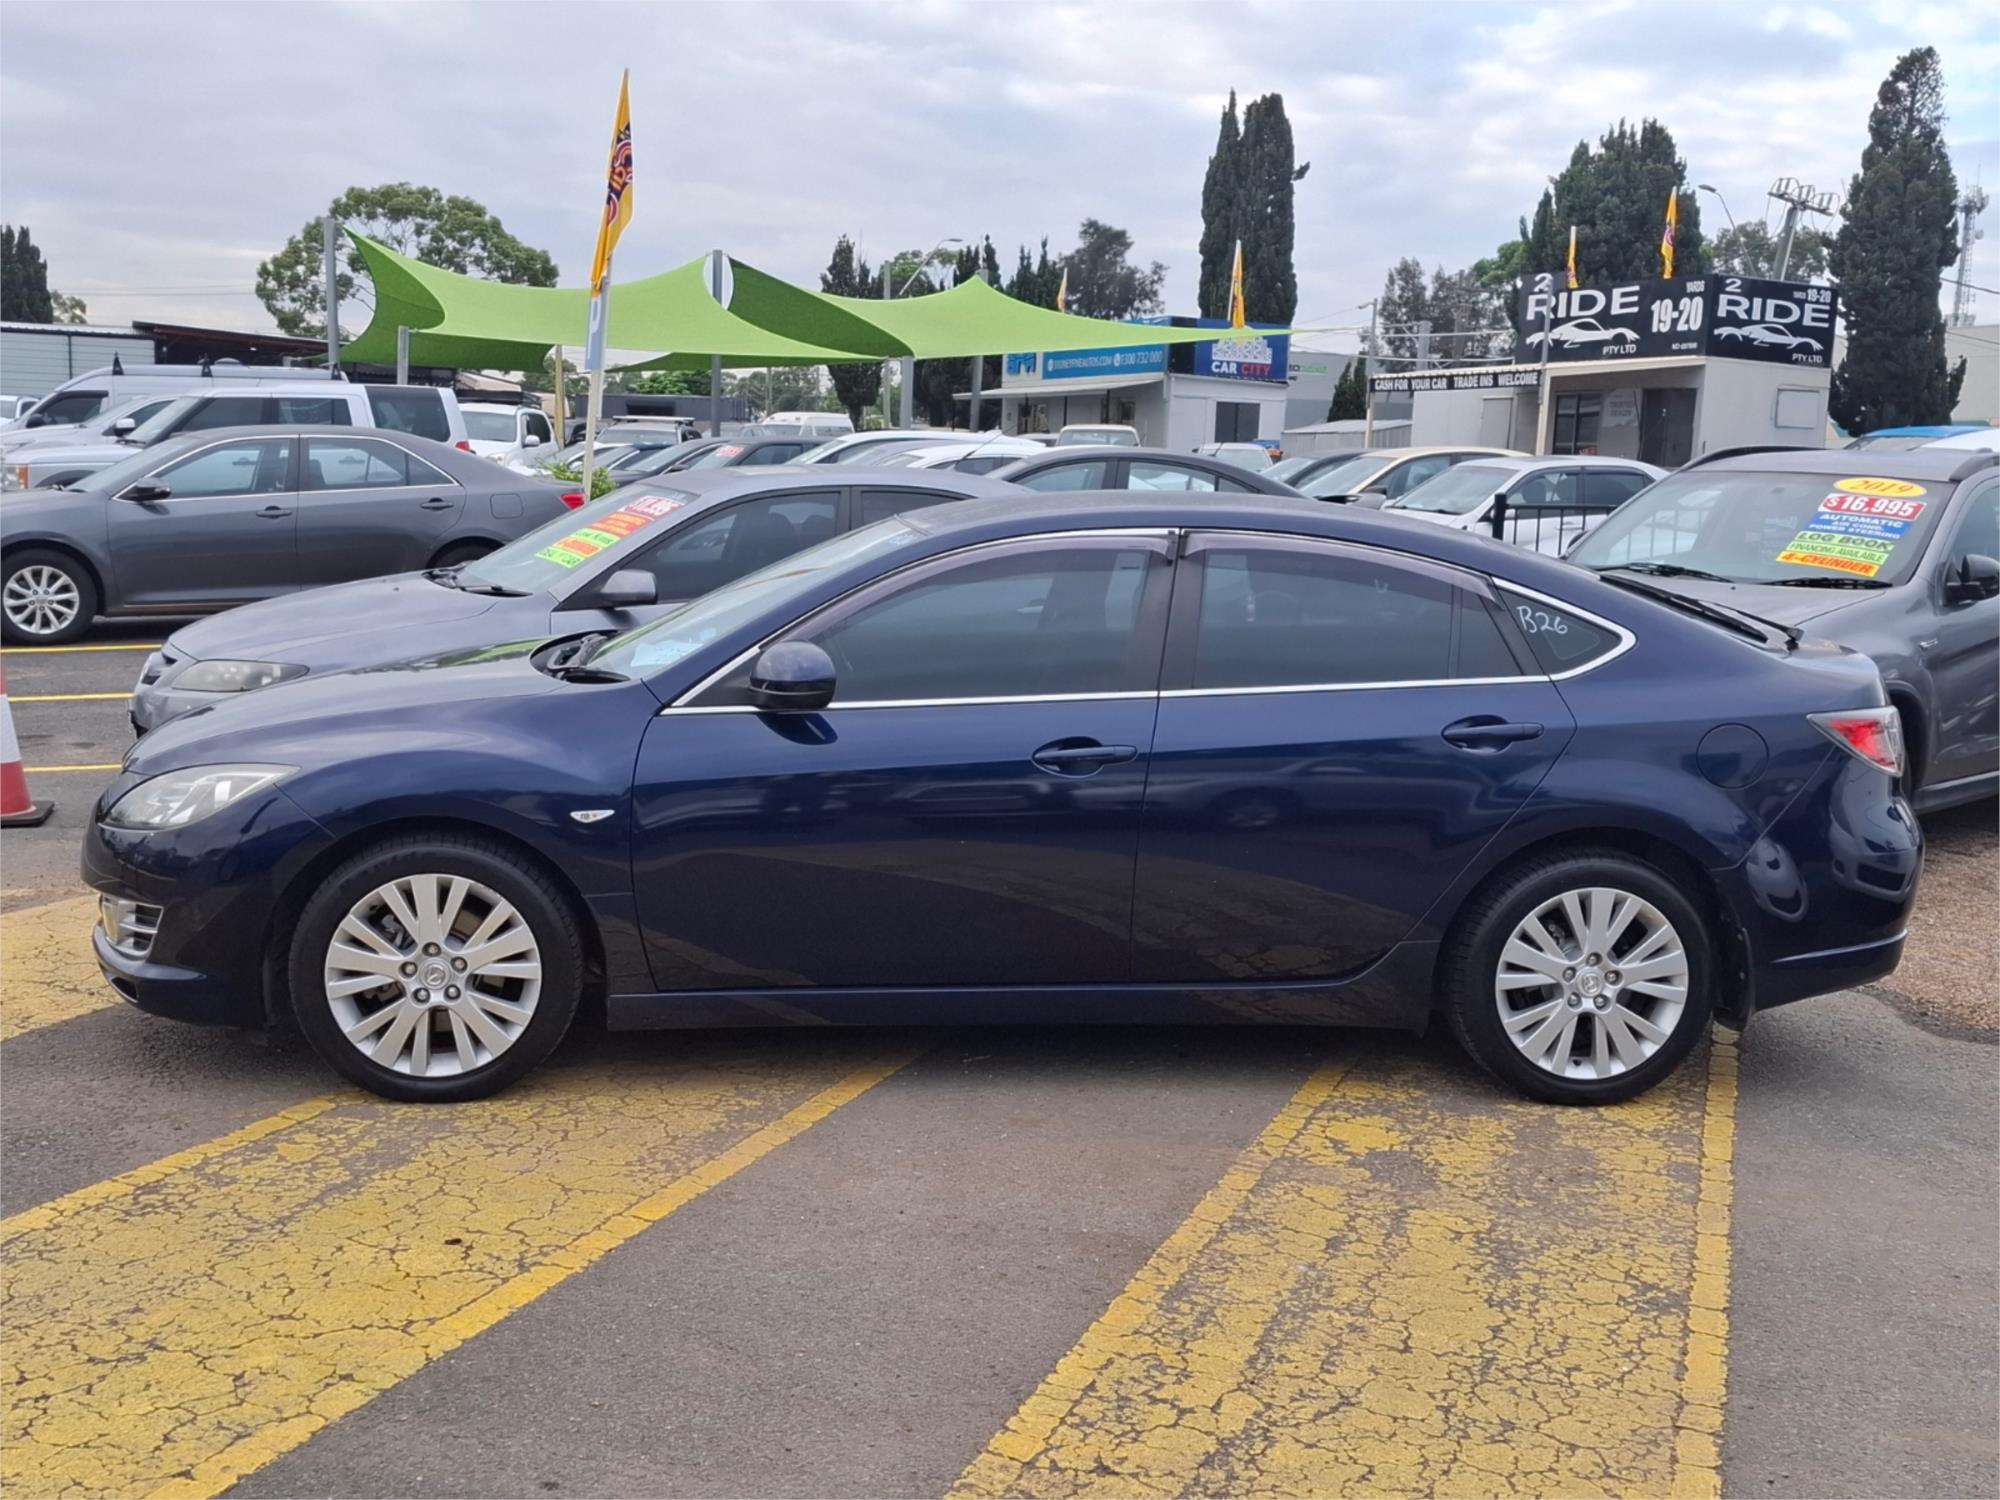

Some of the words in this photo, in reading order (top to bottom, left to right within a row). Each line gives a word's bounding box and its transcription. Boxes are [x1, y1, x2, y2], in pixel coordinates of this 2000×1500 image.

[1725, 278, 1742, 292] 2
[1526, 285, 1640, 320] RIDE
[1807, 288, 1831, 303] 19-20
[1651, 296, 1704, 333] 19-20
[1716, 294, 1831, 329] RIDE
[1603, 345, 1620, 355] PTY
[1621, 344, 1636, 354] LTD
[1792, 353, 1807, 363] PTY
[1808, 354, 1823, 364] LTD
[1211, 361, 1237, 375] CAR
[1242, 363, 1271, 376] CITY
[1374, 380, 1393, 391] CASH
[1394, 379, 1408, 390] FOR
[1411, 378, 1430, 390] YOUR
[1431, 378, 1447, 389] CAR
[1453, 376, 1478, 389] TRADE
[1479, 375, 1493, 387] INS
[1497, 373, 1538, 386] WELCOME
[1849, 480, 1914, 492] 2019
[1827, 496, 1918, 516] $16,995
[1820, 514, 1904, 528] AUTOMATIC
[1798, 532, 1835, 542] LOG
[1838, 534, 1892, 550] BOOK
[1848, 528, 1901, 539] STEERING
[1790, 543, 1835, 554] FINANCING
[1836, 548, 1883, 562] AVAILABLE
[1516, 605, 1568, 635] B26
